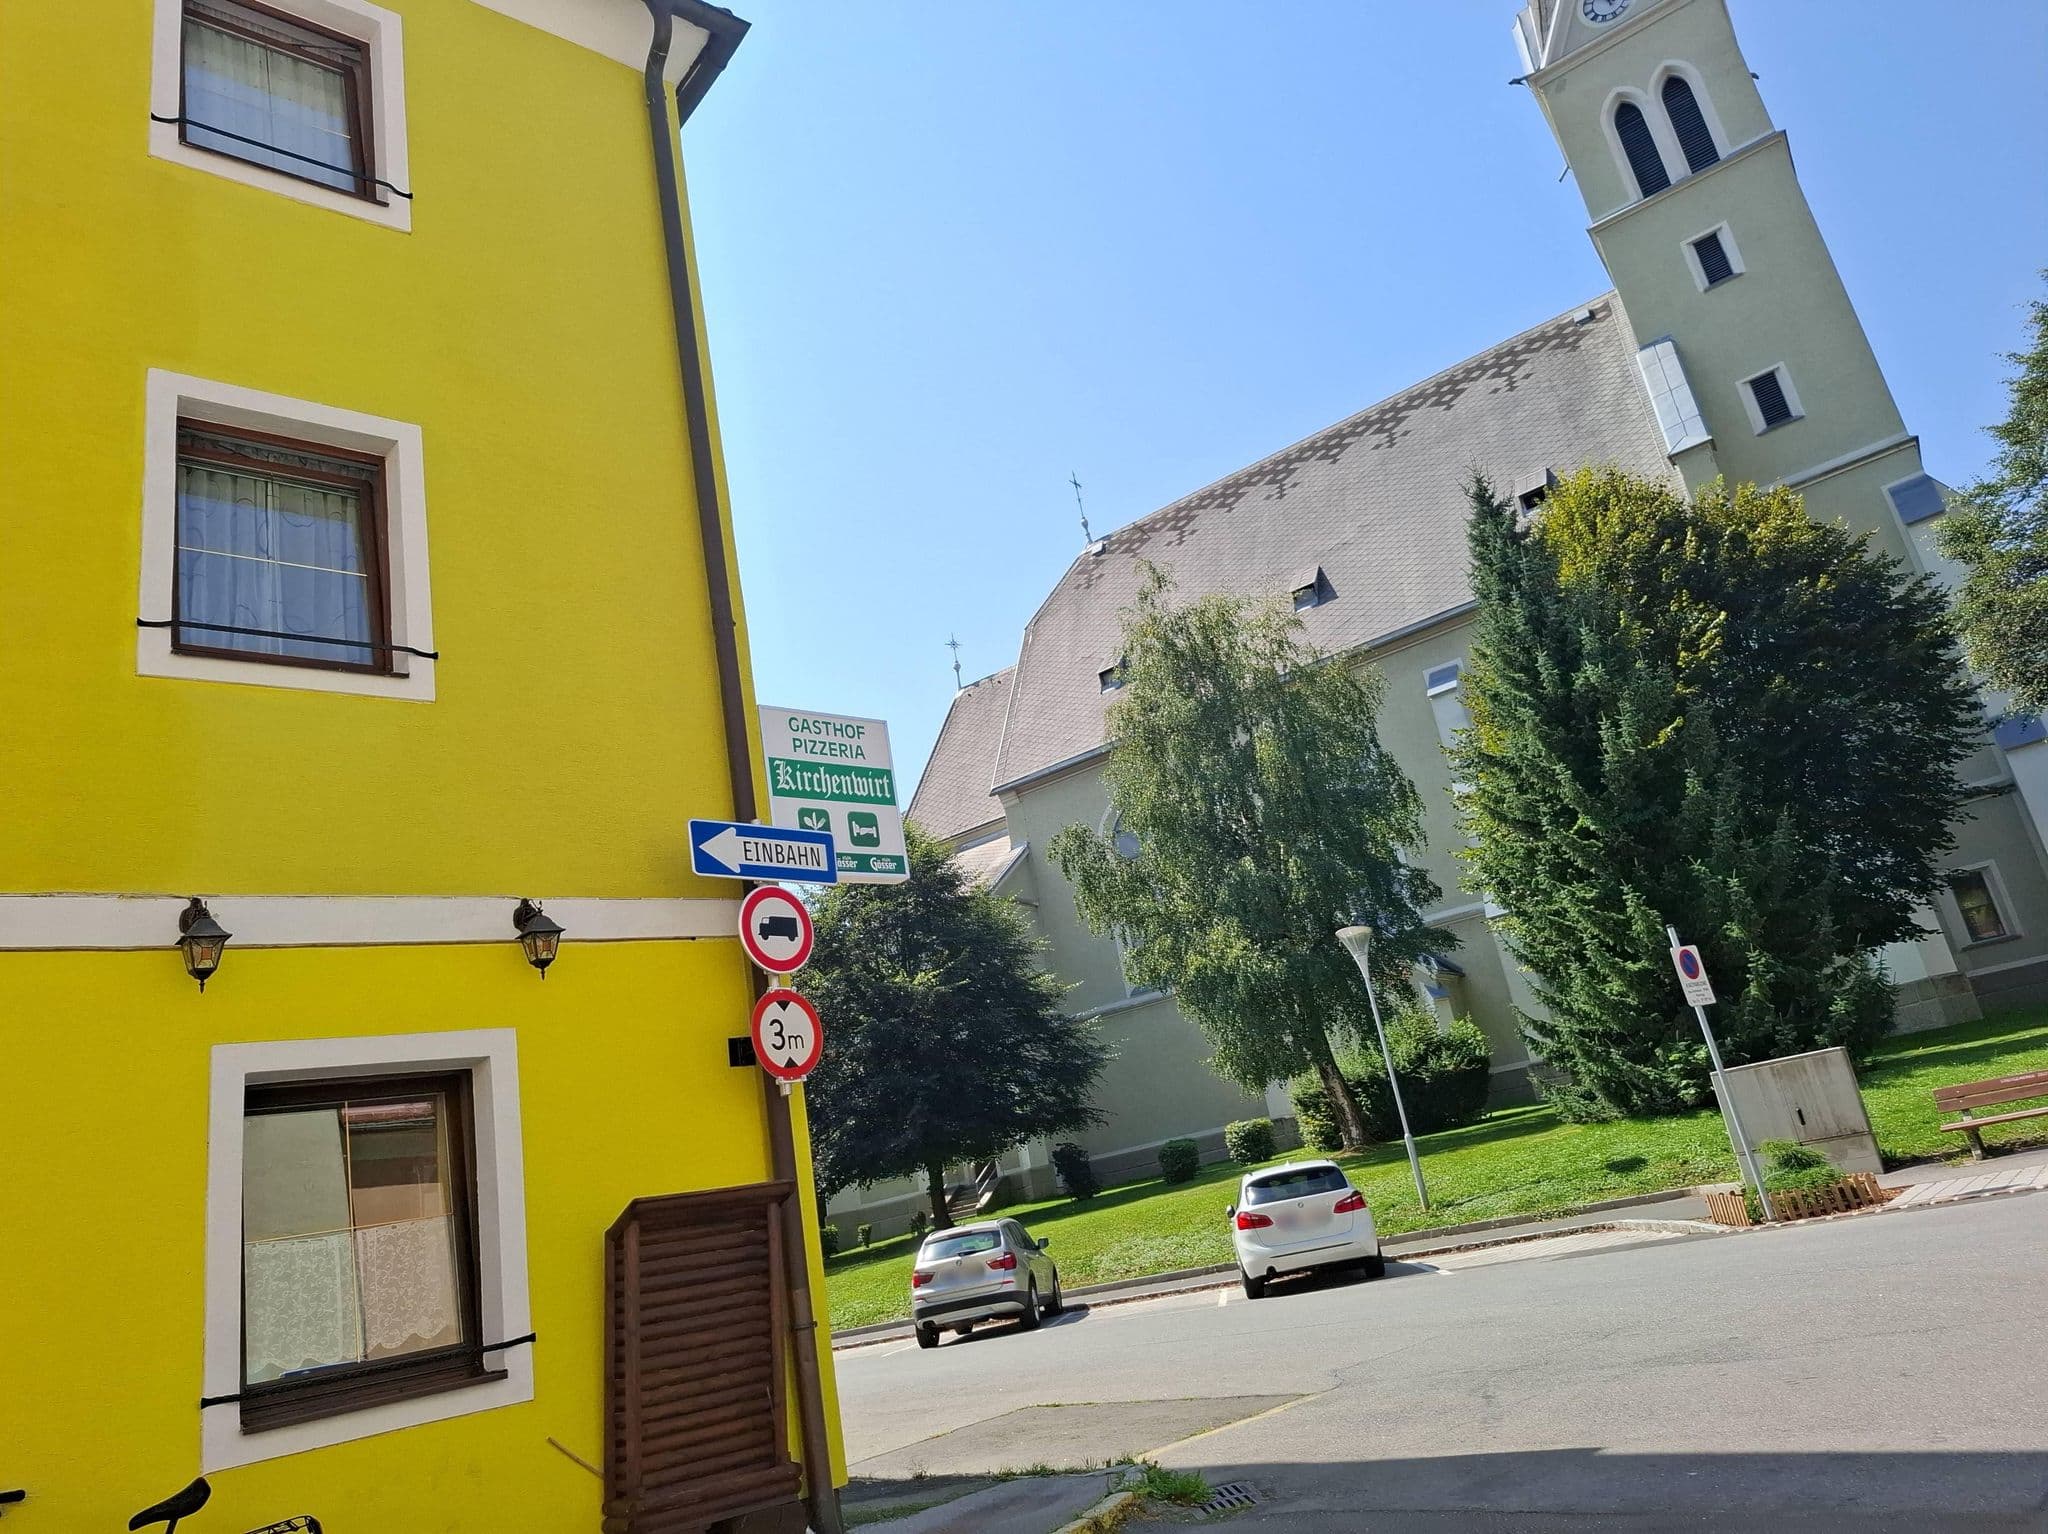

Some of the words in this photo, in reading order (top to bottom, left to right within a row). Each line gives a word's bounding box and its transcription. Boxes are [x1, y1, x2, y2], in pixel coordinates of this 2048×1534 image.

[788, 716, 866, 740] GASTHOF
[792, 737, 866, 760] PIZZERIA
[773, 759, 891, 799] Kirchenwirt
[743, 840, 822, 867] EINBAHN
[836, 857, 858, 869] össer
[869, 857, 897, 871] Gösser
